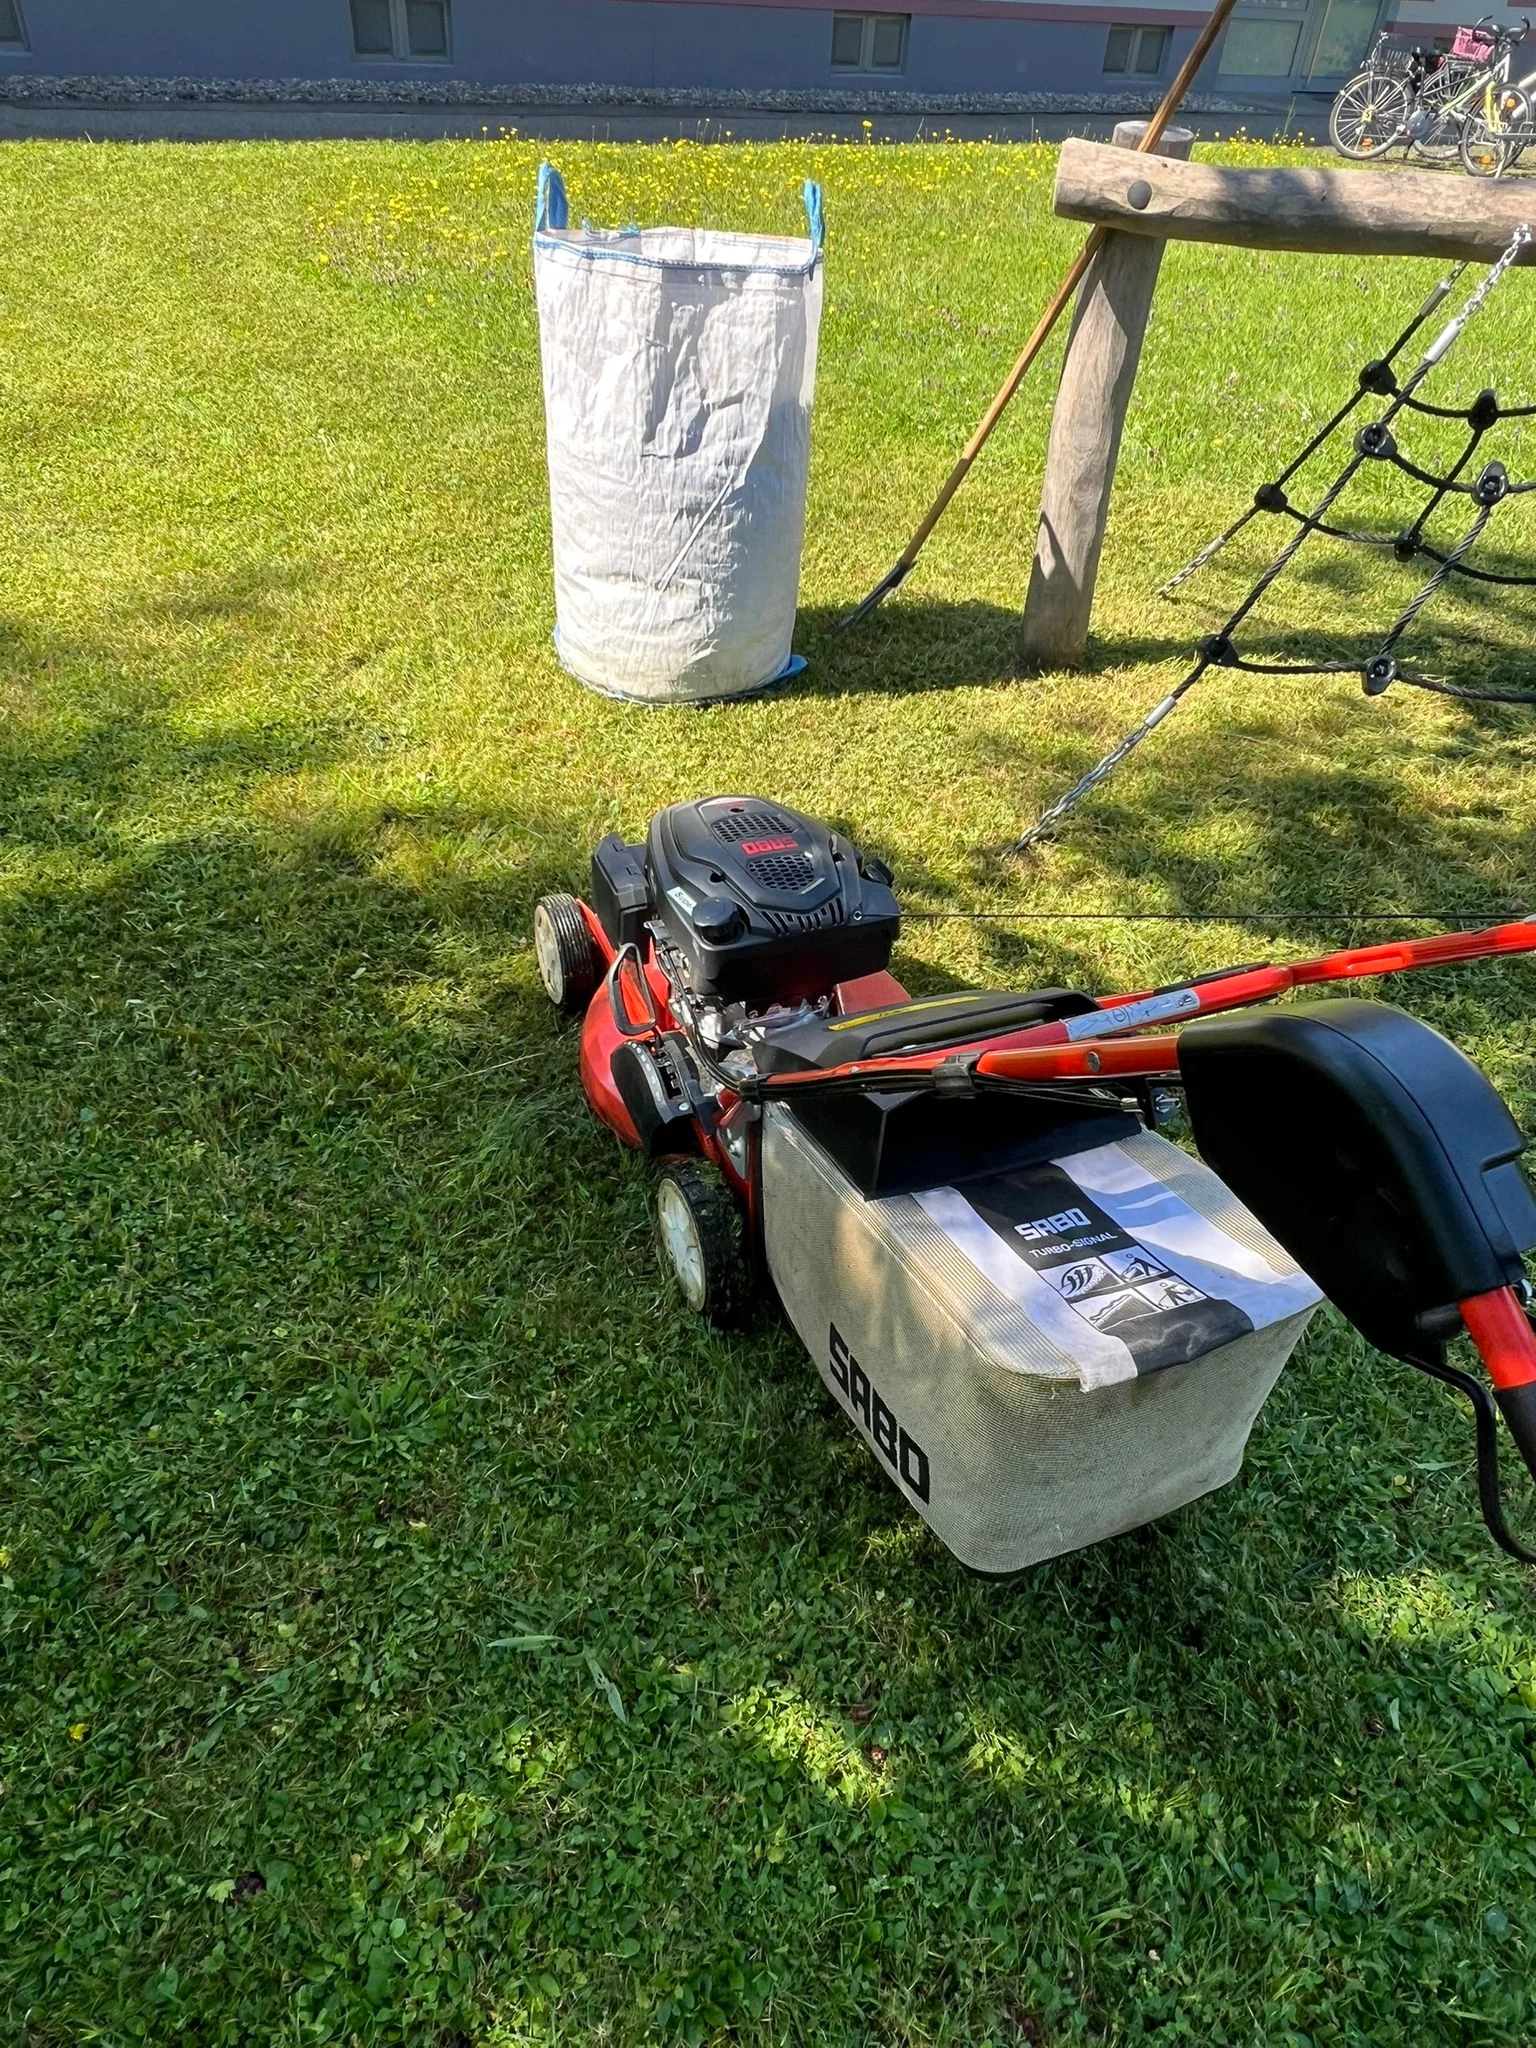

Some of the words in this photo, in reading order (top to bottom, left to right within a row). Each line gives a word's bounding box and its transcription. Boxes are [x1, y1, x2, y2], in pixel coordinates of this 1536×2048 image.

[1014, 1207, 1092, 1241] SABO
[1028, 1232, 1118, 1258] TURBO-SIGNAL
[829, 1321, 930, 1506] SABO
